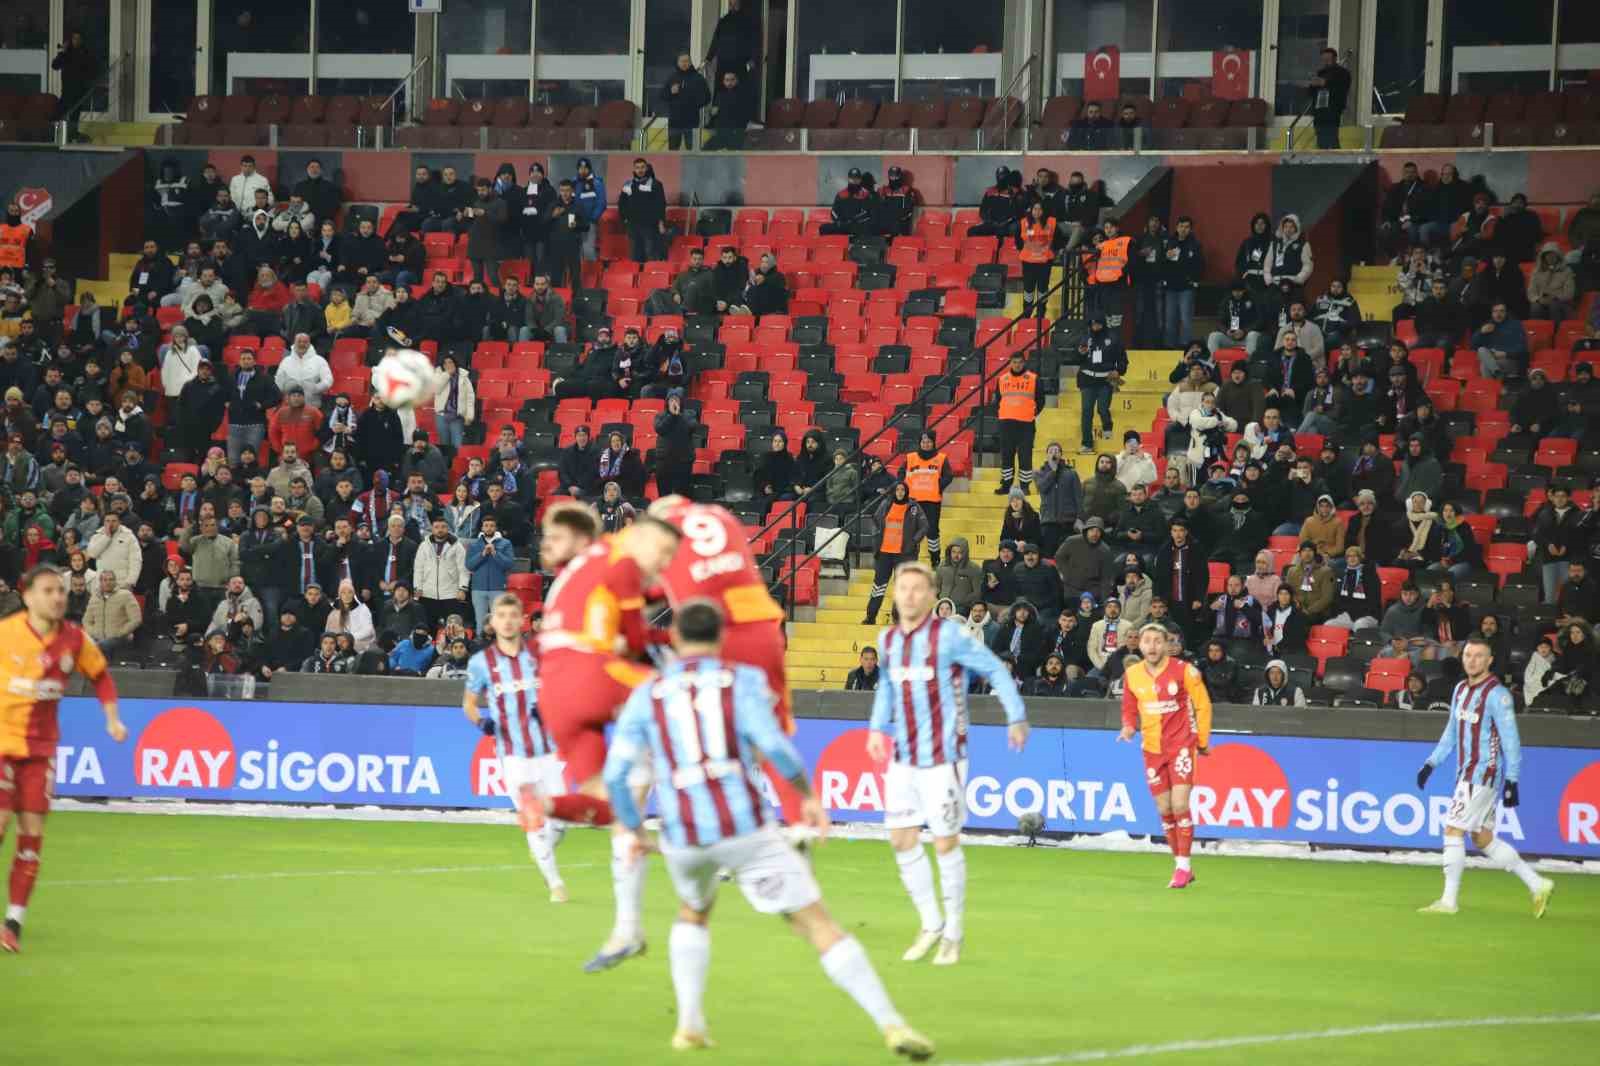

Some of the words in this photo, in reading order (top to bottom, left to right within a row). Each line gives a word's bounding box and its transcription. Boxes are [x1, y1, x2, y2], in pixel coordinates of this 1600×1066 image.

[1123, 400, 1132, 410] 15
[681, 512, 728, 557] 9
[976, 534, 985, 545] 10
[820, 669, 825, 681] 5
[141, 748, 232, 788] RAY
[1173, 756, 1192, 774] 53
[821, 770, 885, 811] RA
[966, 775, 1137, 823] GORTA
[1188, 784, 1288, 829] RAY
